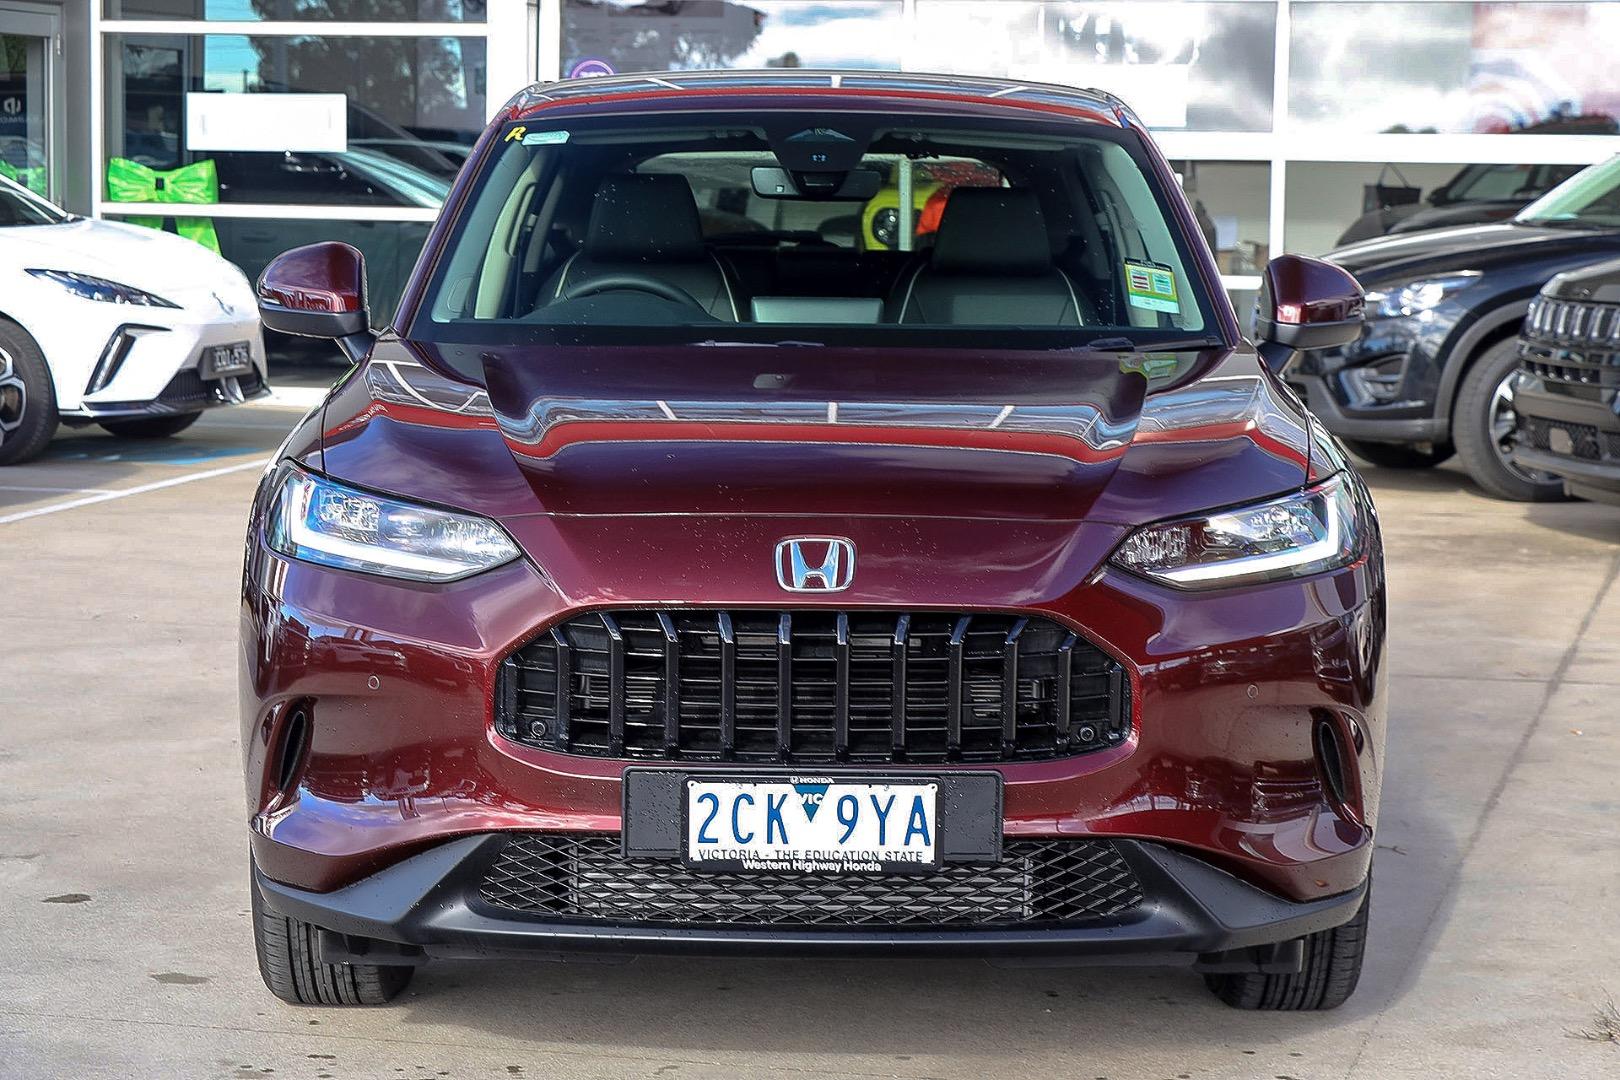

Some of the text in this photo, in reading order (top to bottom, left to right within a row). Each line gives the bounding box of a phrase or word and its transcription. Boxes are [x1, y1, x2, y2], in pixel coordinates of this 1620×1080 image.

[801, 793, 824, 804] VIC
[697, 793, 931, 846] 2CK 9YA
[698, 849, 760, 859] VICTORIA
[775, 849, 800, 860] THE
[804, 850, 880, 860] EDUCATION
[884, 851, 923, 861] STATE
[743, 860, 882, 873] Western Highway Honda
